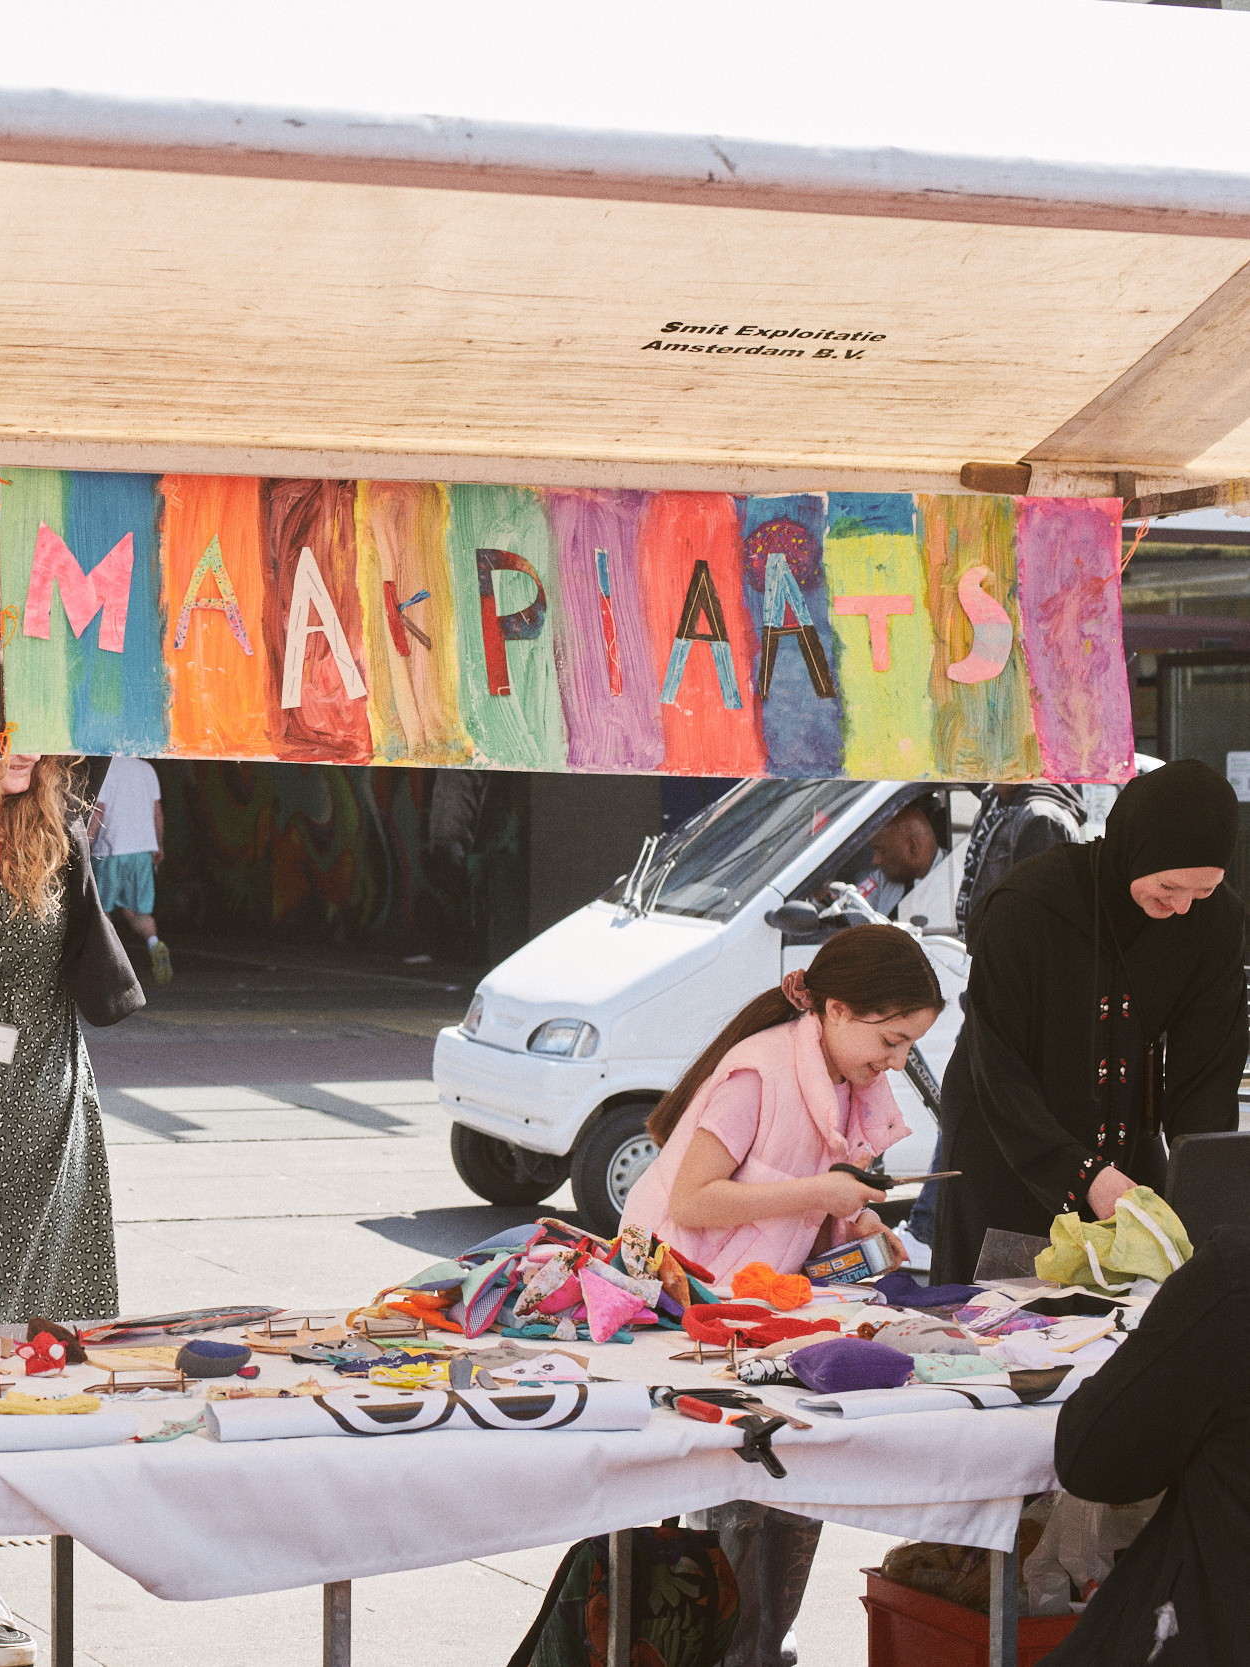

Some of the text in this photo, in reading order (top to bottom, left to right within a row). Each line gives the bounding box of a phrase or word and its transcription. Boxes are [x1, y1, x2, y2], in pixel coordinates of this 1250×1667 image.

[660, 321, 887, 343] Smit Exploitatie
[640, 340, 867, 360] Amsterdam B.V.
